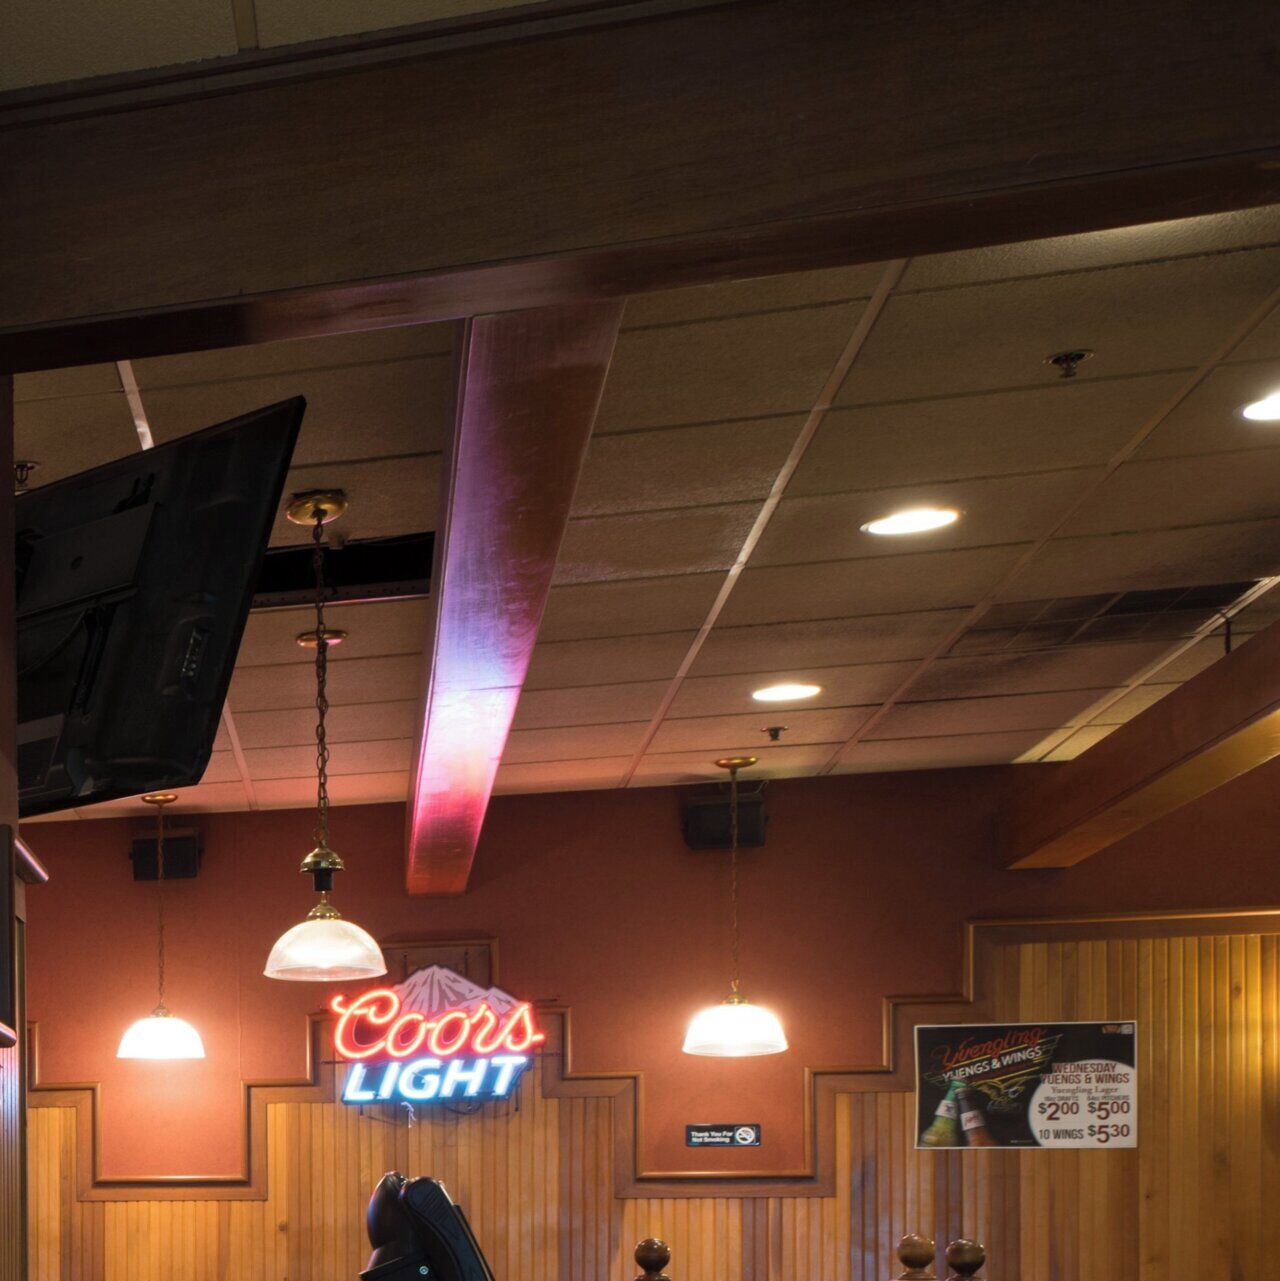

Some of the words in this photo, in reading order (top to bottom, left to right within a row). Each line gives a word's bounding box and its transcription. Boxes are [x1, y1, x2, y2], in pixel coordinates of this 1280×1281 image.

[330, 988, 545, 1059] Coors
[931, 1027, 1048, 1070] Yuengling
[991, 1058, 1001, 1069] &
[1002, 1045, 1042, 1066] WINGS
[1052, 1062, 1118, 1073] WEDNESDAY
[343, 1055, 529, 1101] LIGHT
[1041, 1073, 1081, 1084] YUENGS
[1084, 1074, 1092, 1084] &
[1095, 1073, 1130, 1083] WINGS
[1051, 1086, 1093, 1095] Yuengling
[1095, 1085, 1119, 1095] Lager
[1039, 1129, 1050, 1139] 10
[1053, 1128, 1084, 1139] WINGS
